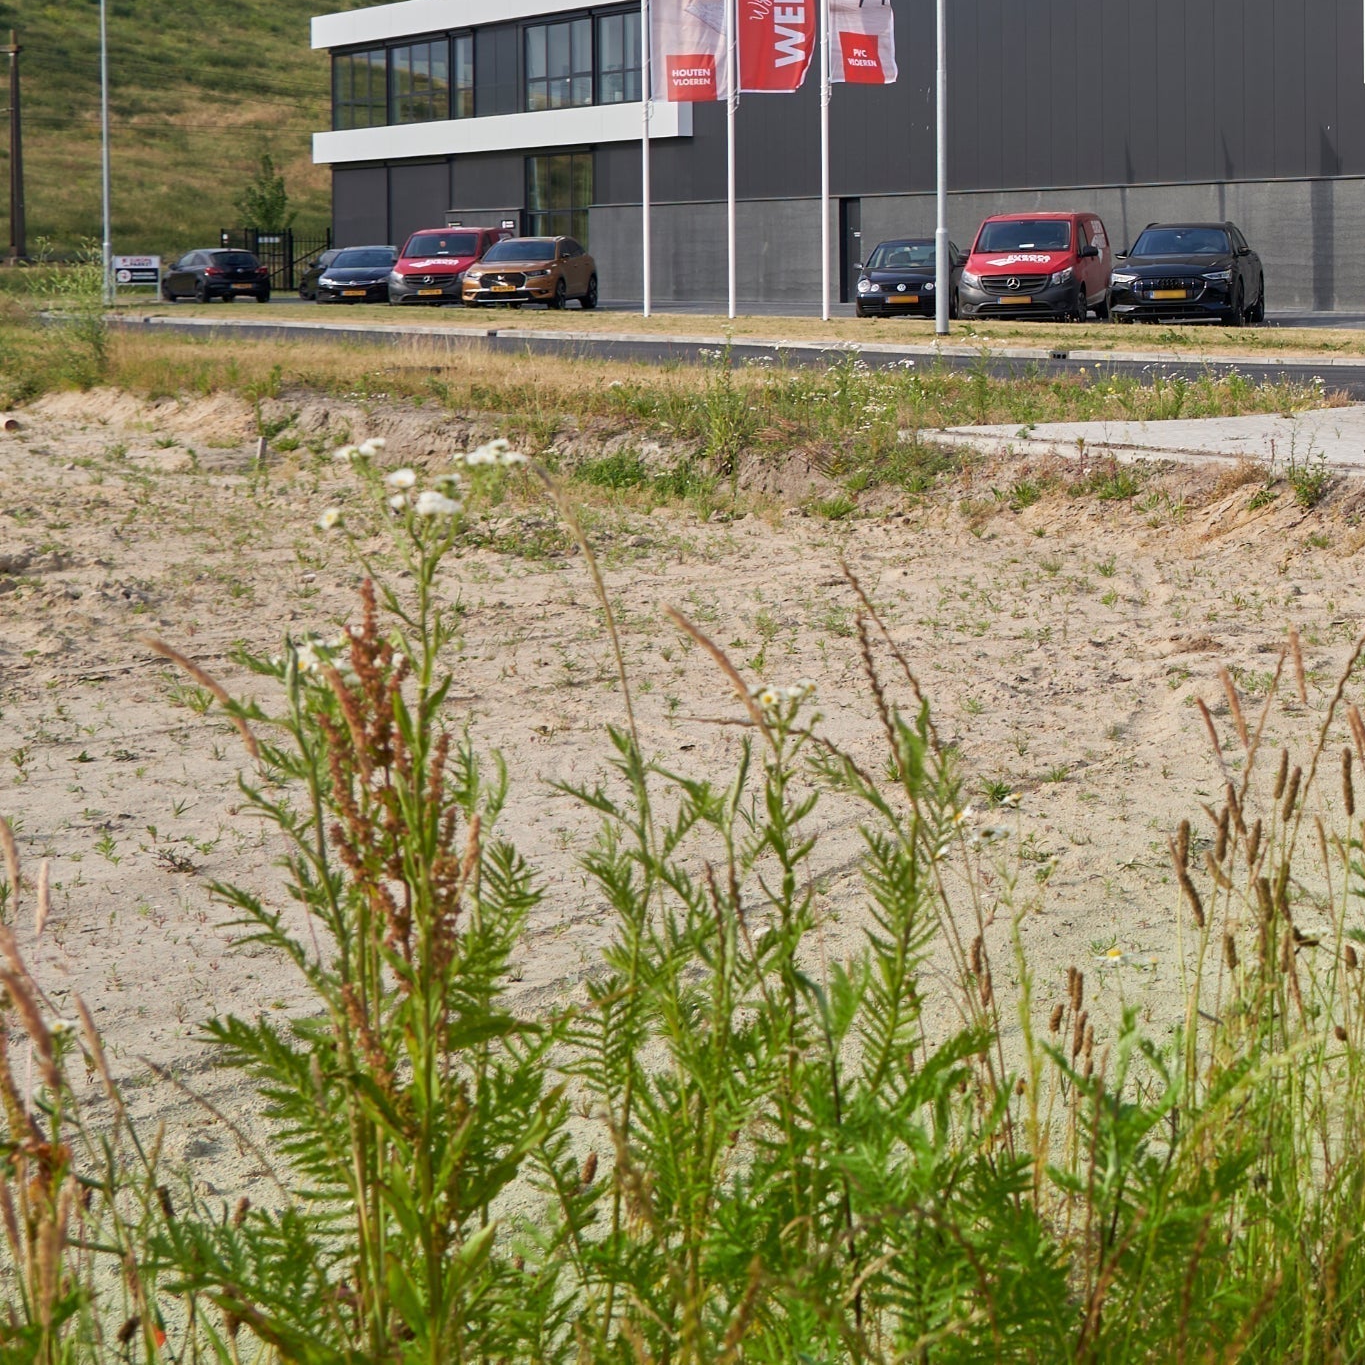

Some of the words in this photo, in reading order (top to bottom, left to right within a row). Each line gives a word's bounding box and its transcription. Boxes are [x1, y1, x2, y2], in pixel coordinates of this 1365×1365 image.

[853, 48, 867, 57] PVC
[847, 58, 877, 67] VLOEREN
[672, 68, 711, 77] HOUTEN
[673, 78, 711, 86] VLOEREN
